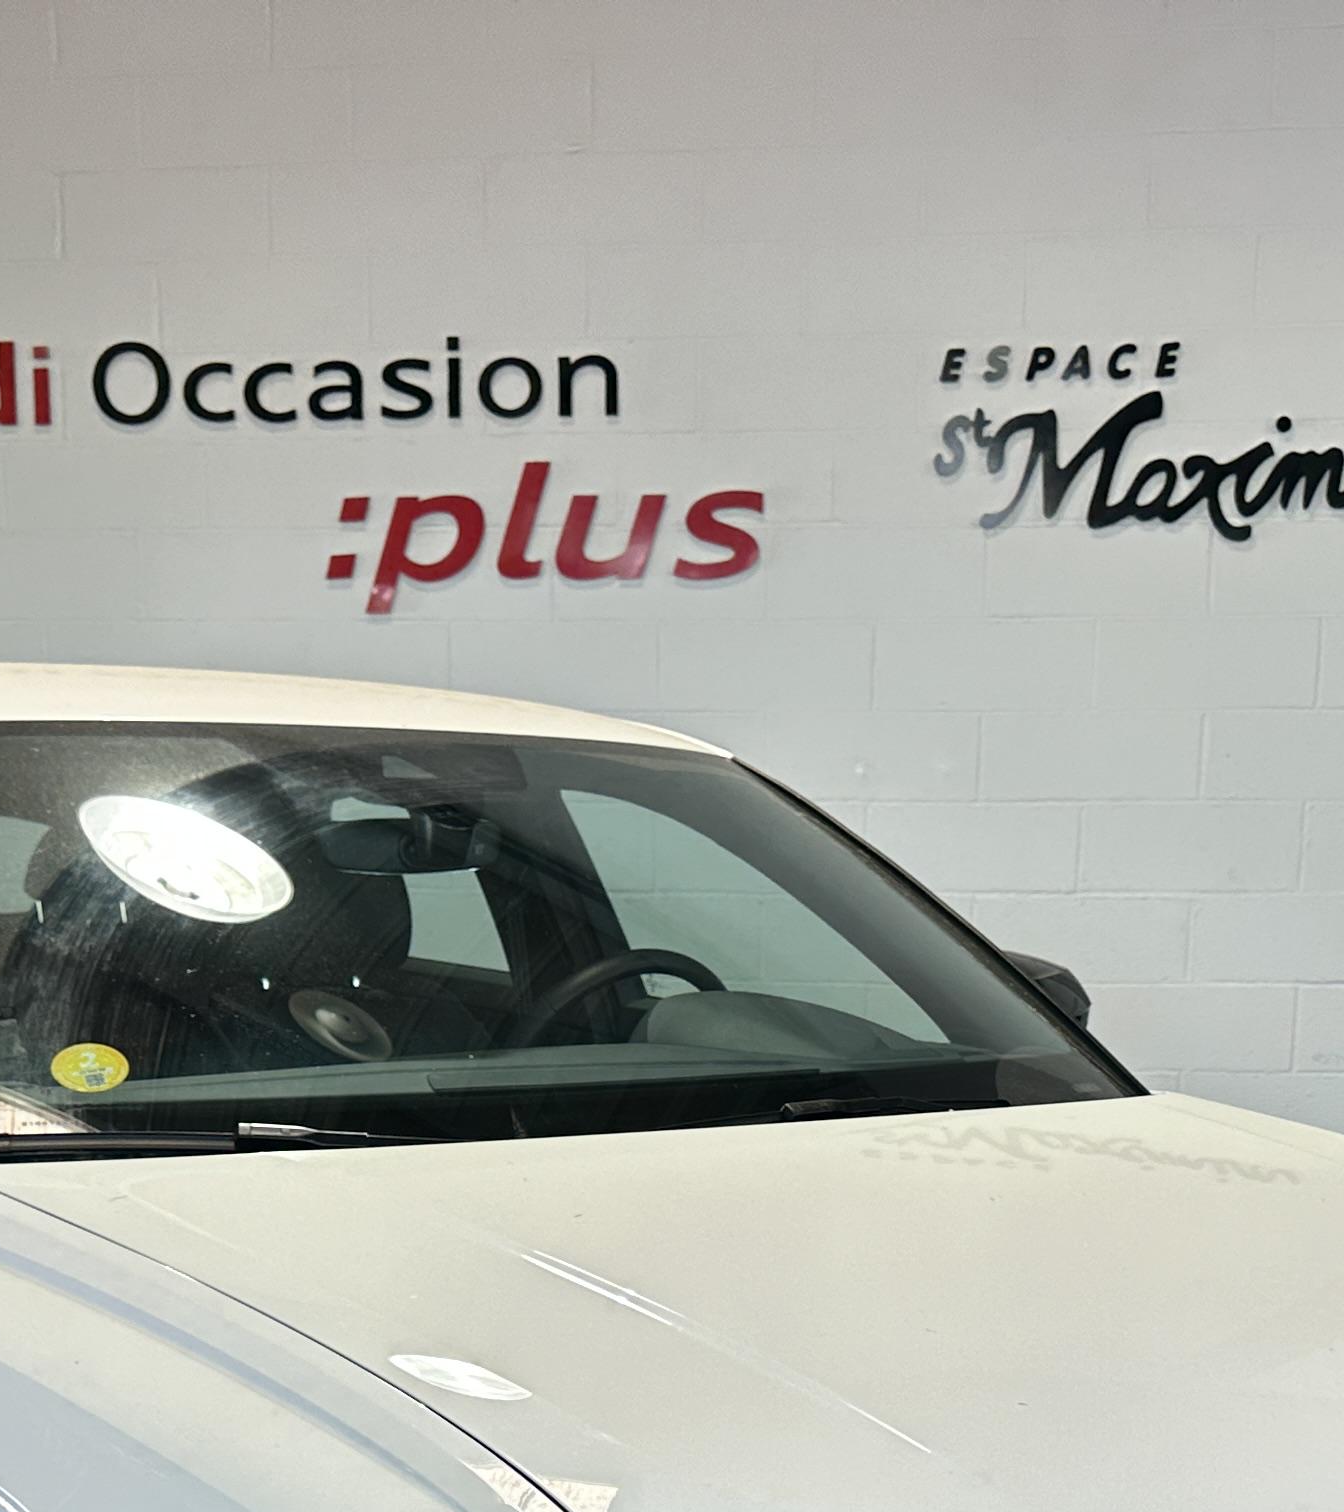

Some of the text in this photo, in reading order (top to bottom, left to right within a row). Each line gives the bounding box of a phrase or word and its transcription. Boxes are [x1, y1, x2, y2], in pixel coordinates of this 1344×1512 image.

[90, 336, 619, 425] Occasion
[939, 341, 1181, 383] ESPACE
[325, 460, 764, 614] :plus
